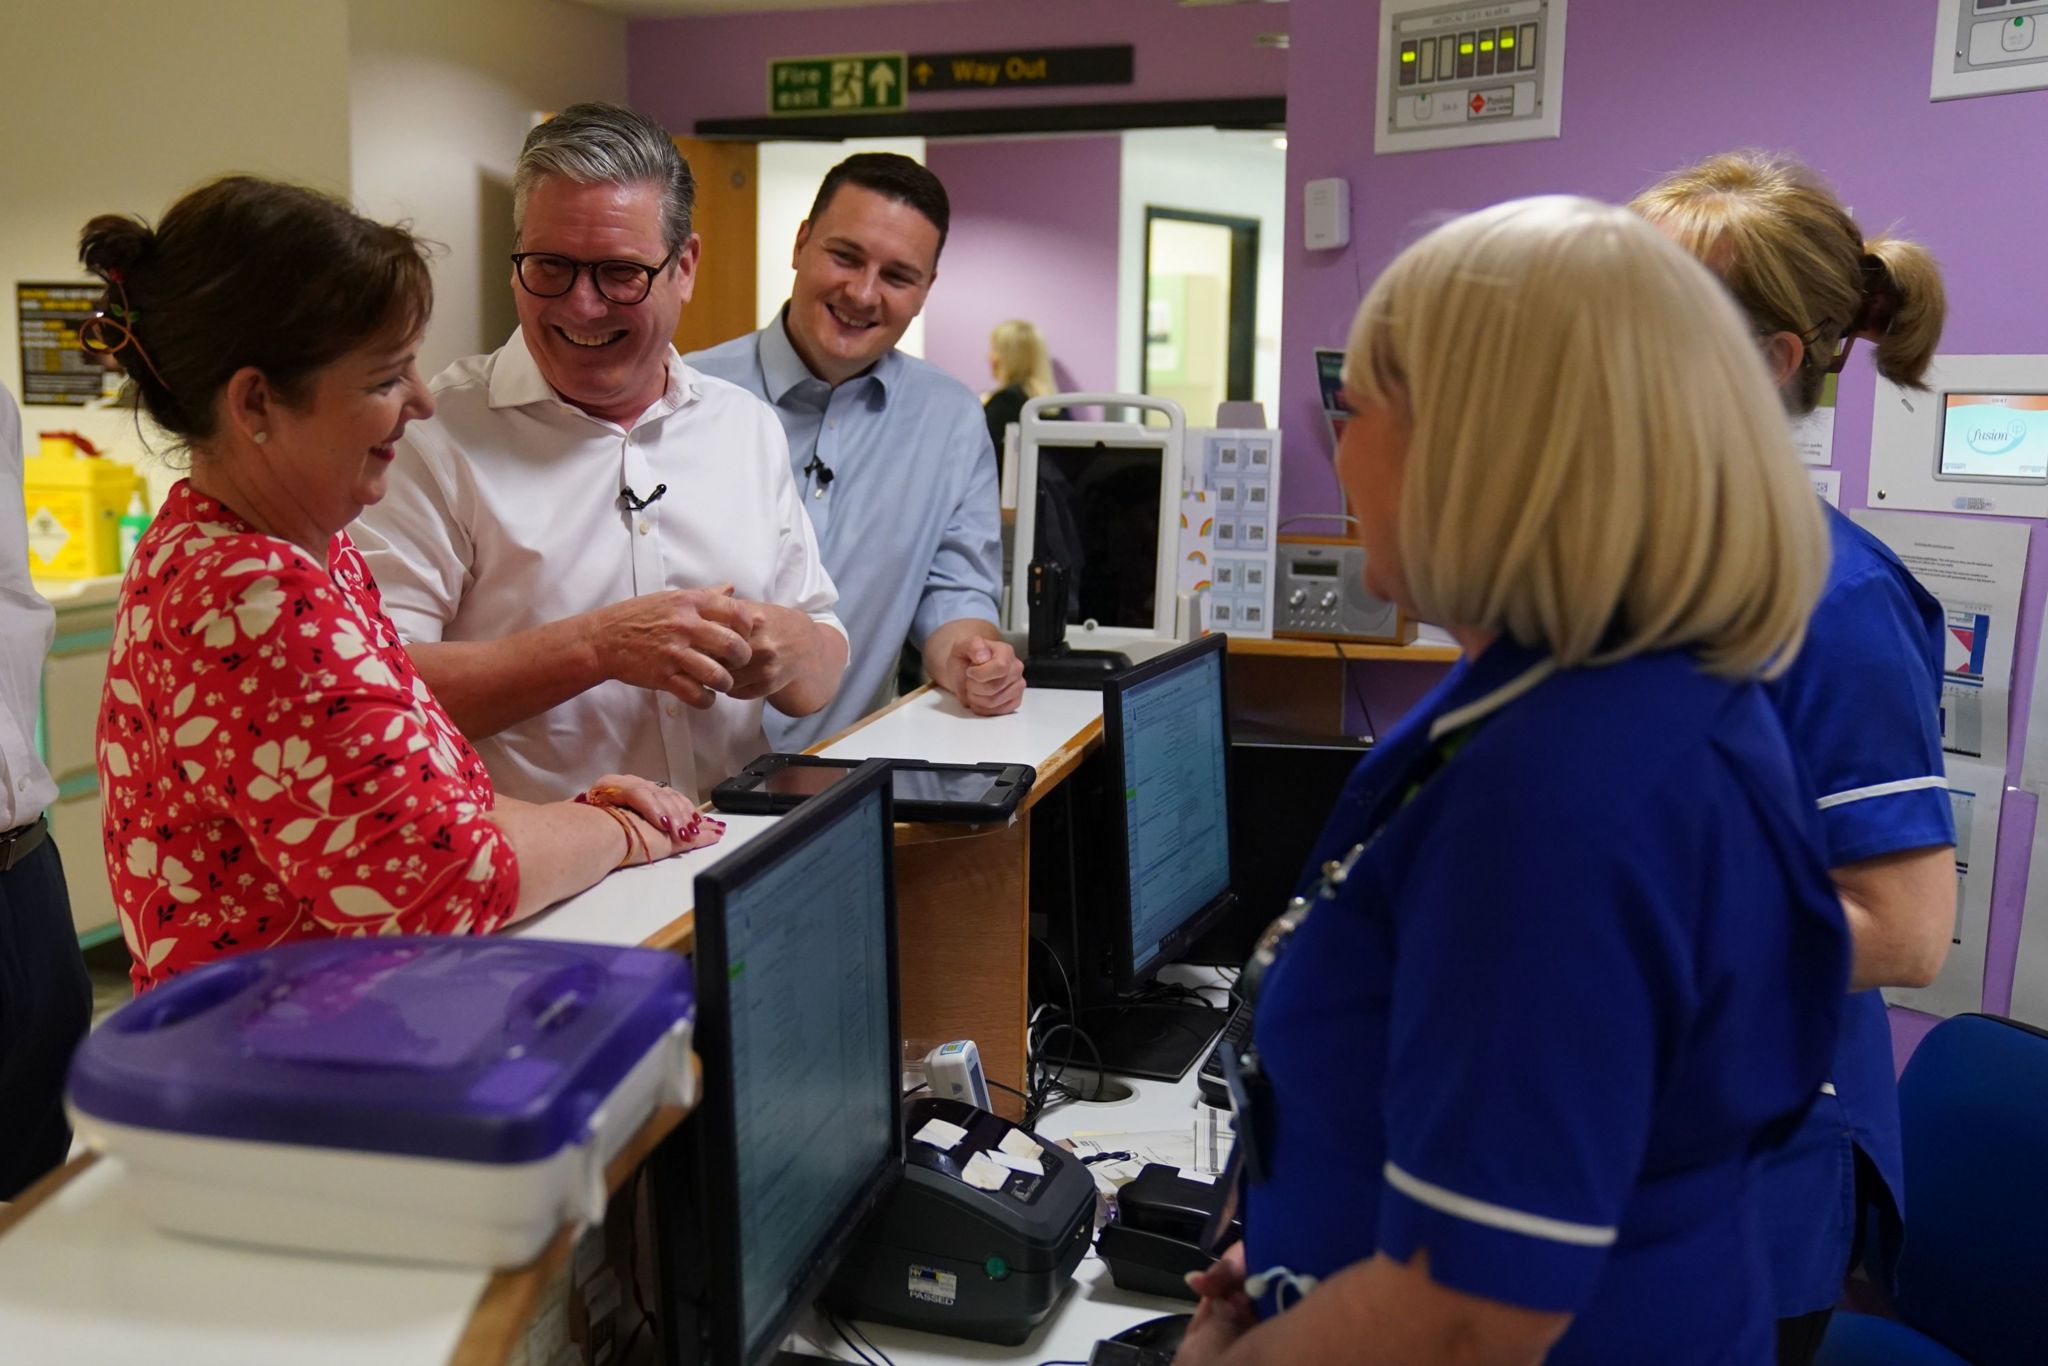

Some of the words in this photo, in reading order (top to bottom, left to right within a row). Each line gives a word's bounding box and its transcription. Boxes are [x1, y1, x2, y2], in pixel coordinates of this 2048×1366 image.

[777, 65, 821, 86] Fire
[952, 60, 999, 85] Way
[1005, 56, 1047, 80] Out
[777, 88, 819, 107] exit
[1969, 428, 2008, 443] fusion
